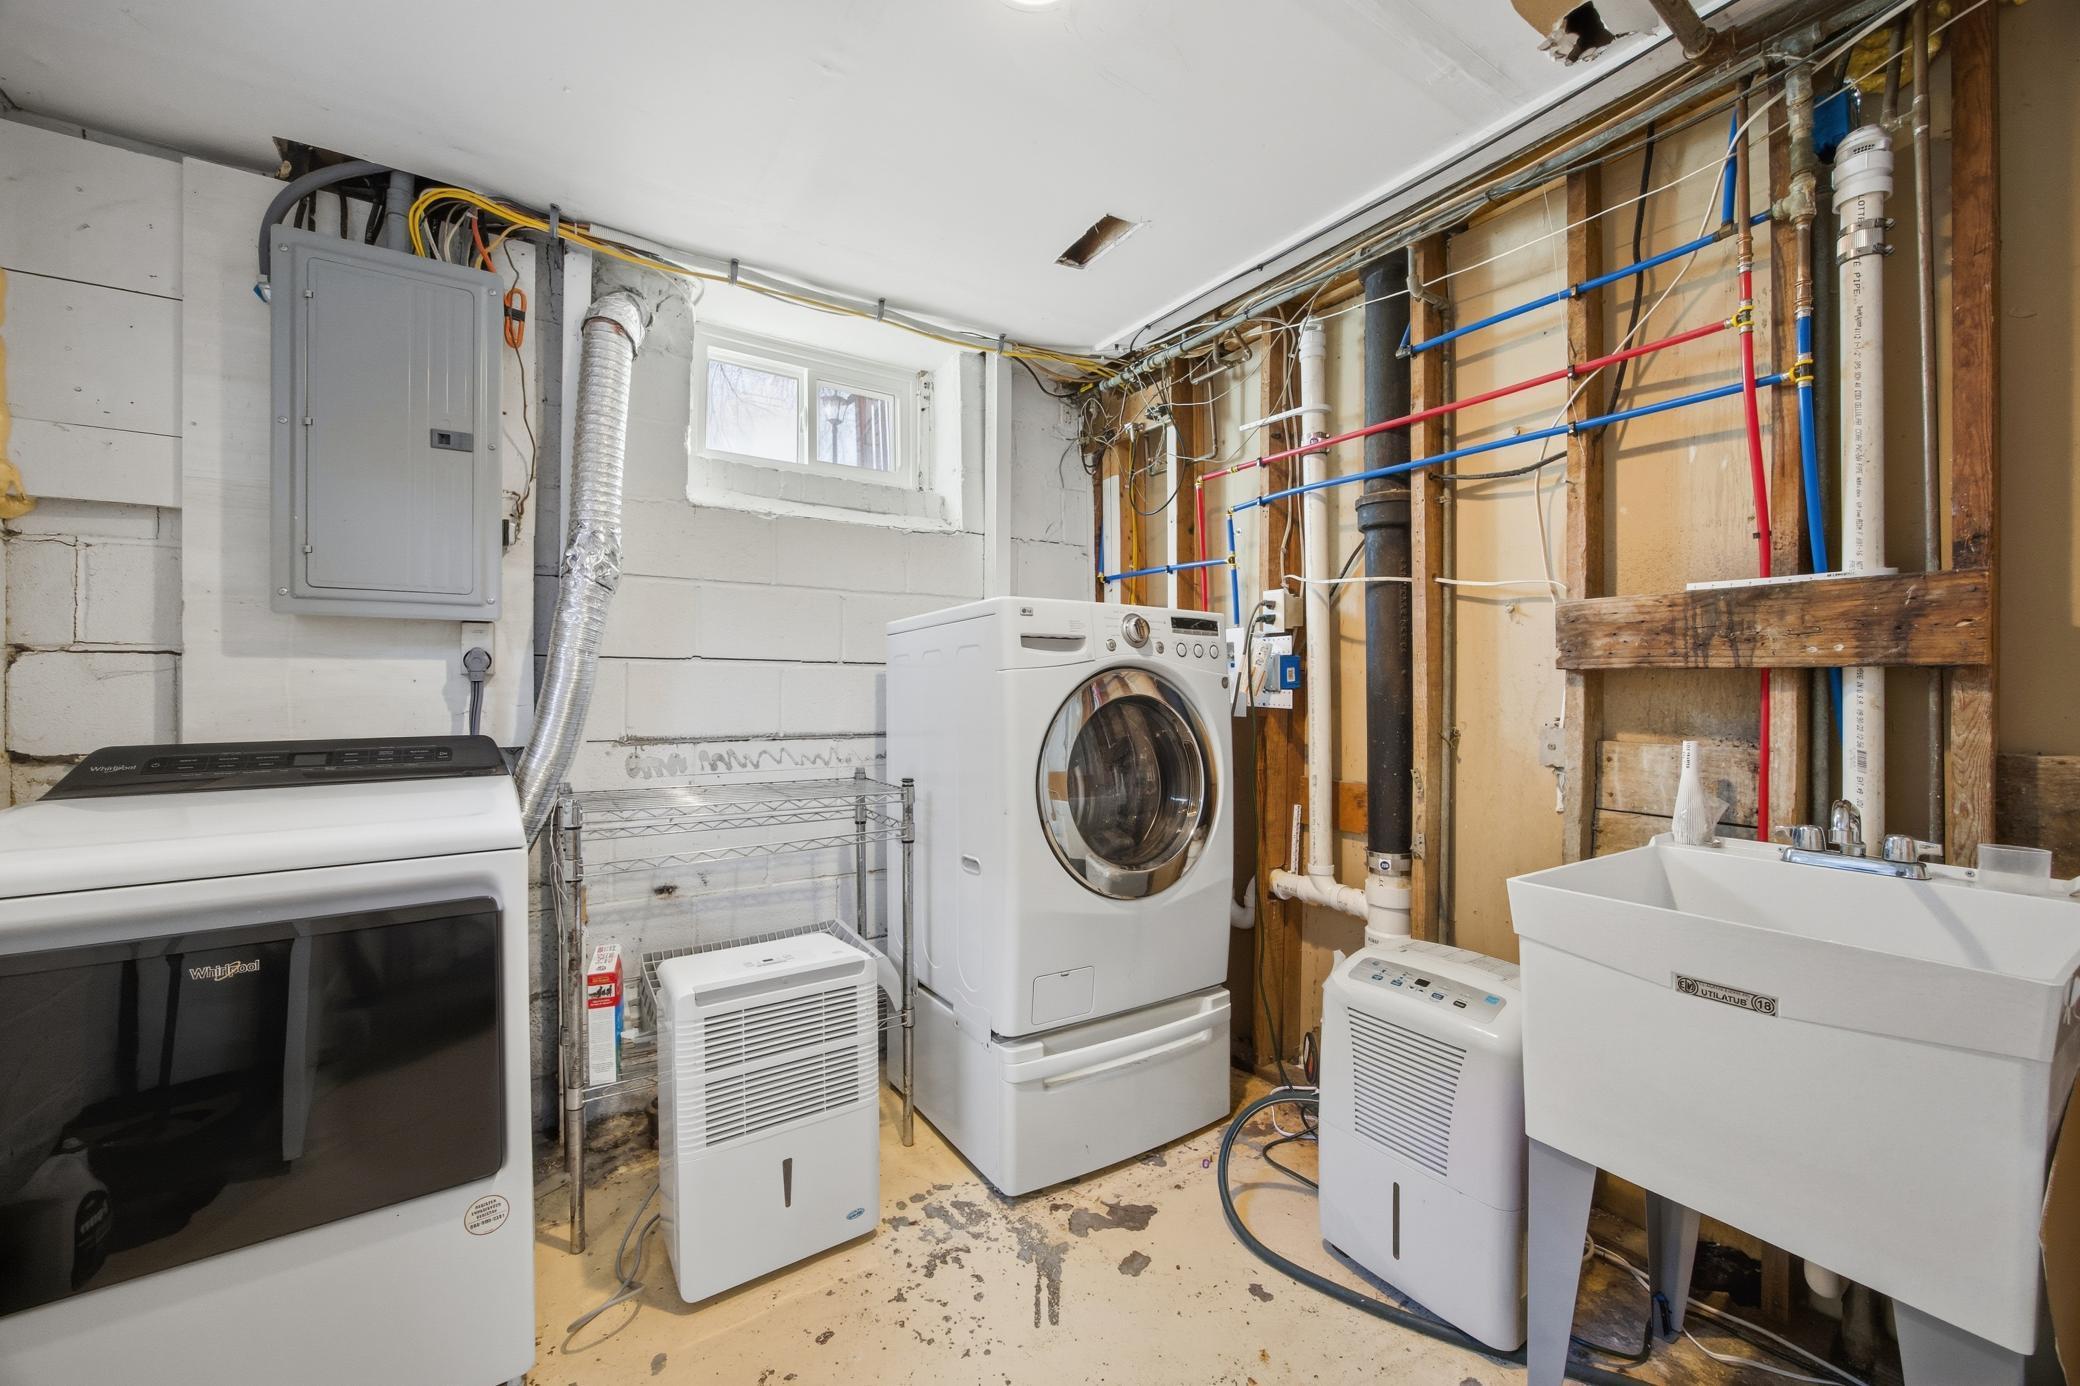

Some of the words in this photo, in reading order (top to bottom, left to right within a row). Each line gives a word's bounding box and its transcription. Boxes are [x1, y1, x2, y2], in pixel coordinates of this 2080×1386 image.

[1853, 272, 1861, 295] PIPE
[188, 959, 261, 982] Whirlpool
[1701, 989, 1748, 1006] UTILATUB
[1757, 1000, 1772, 1011] 18
